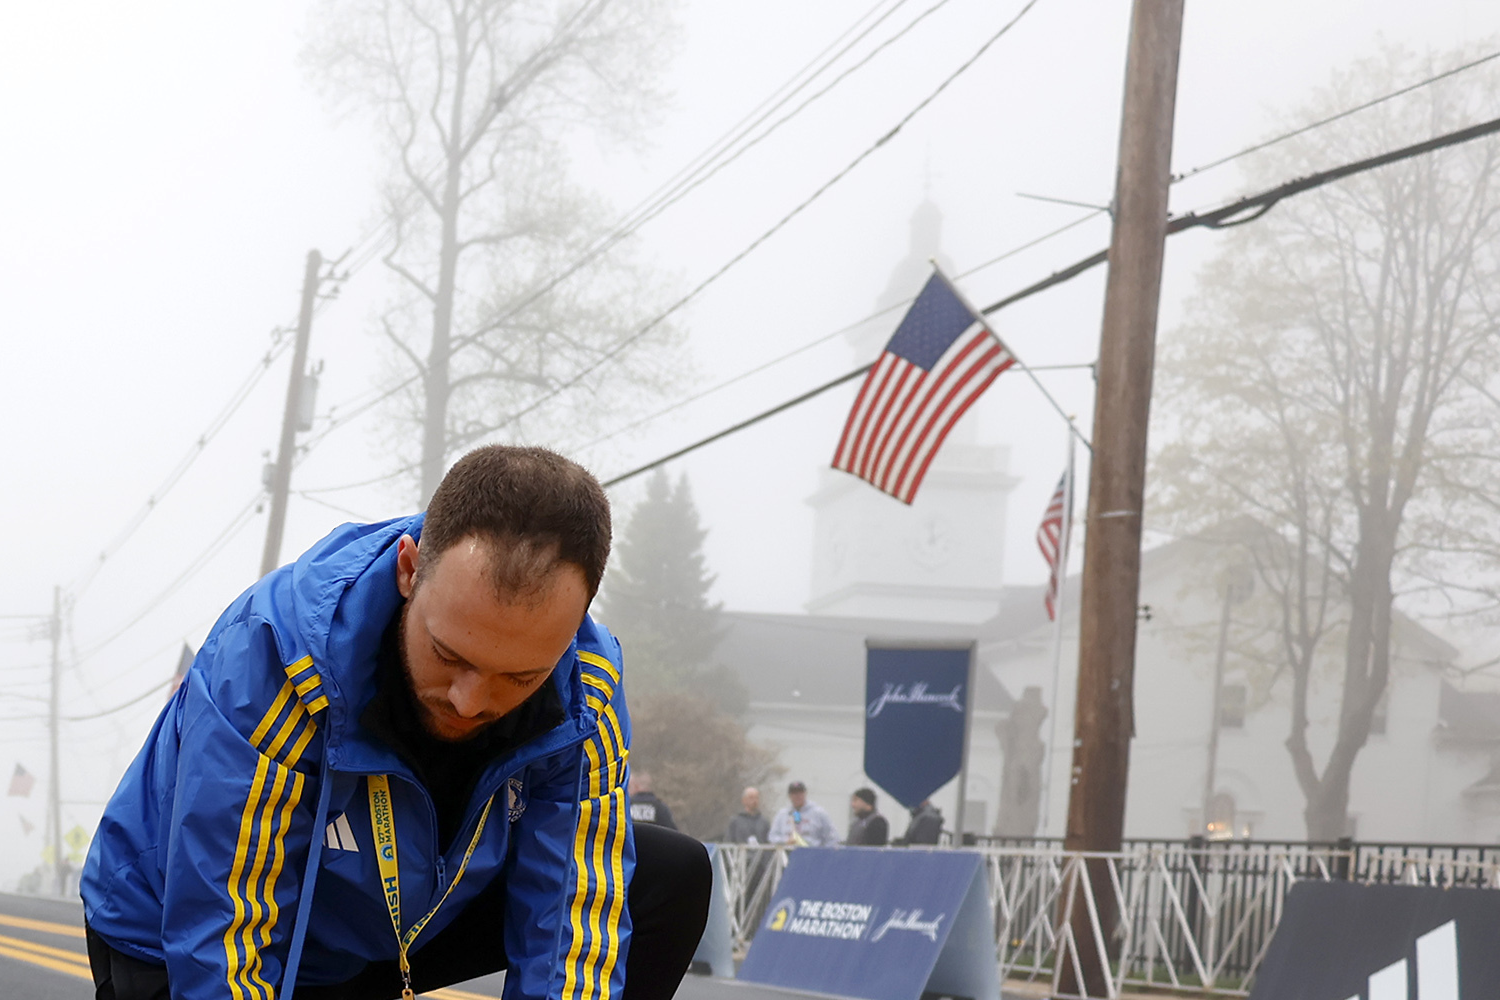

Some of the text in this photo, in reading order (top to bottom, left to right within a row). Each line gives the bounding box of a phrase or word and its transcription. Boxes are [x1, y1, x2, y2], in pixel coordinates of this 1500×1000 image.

[373, 791, 383, 825] BOSTON
[380, 791, 392, 843] MARATHON
[798, 900, 872, 921] THE BOSTON
[789, 918, 866, 940] MARATHON
